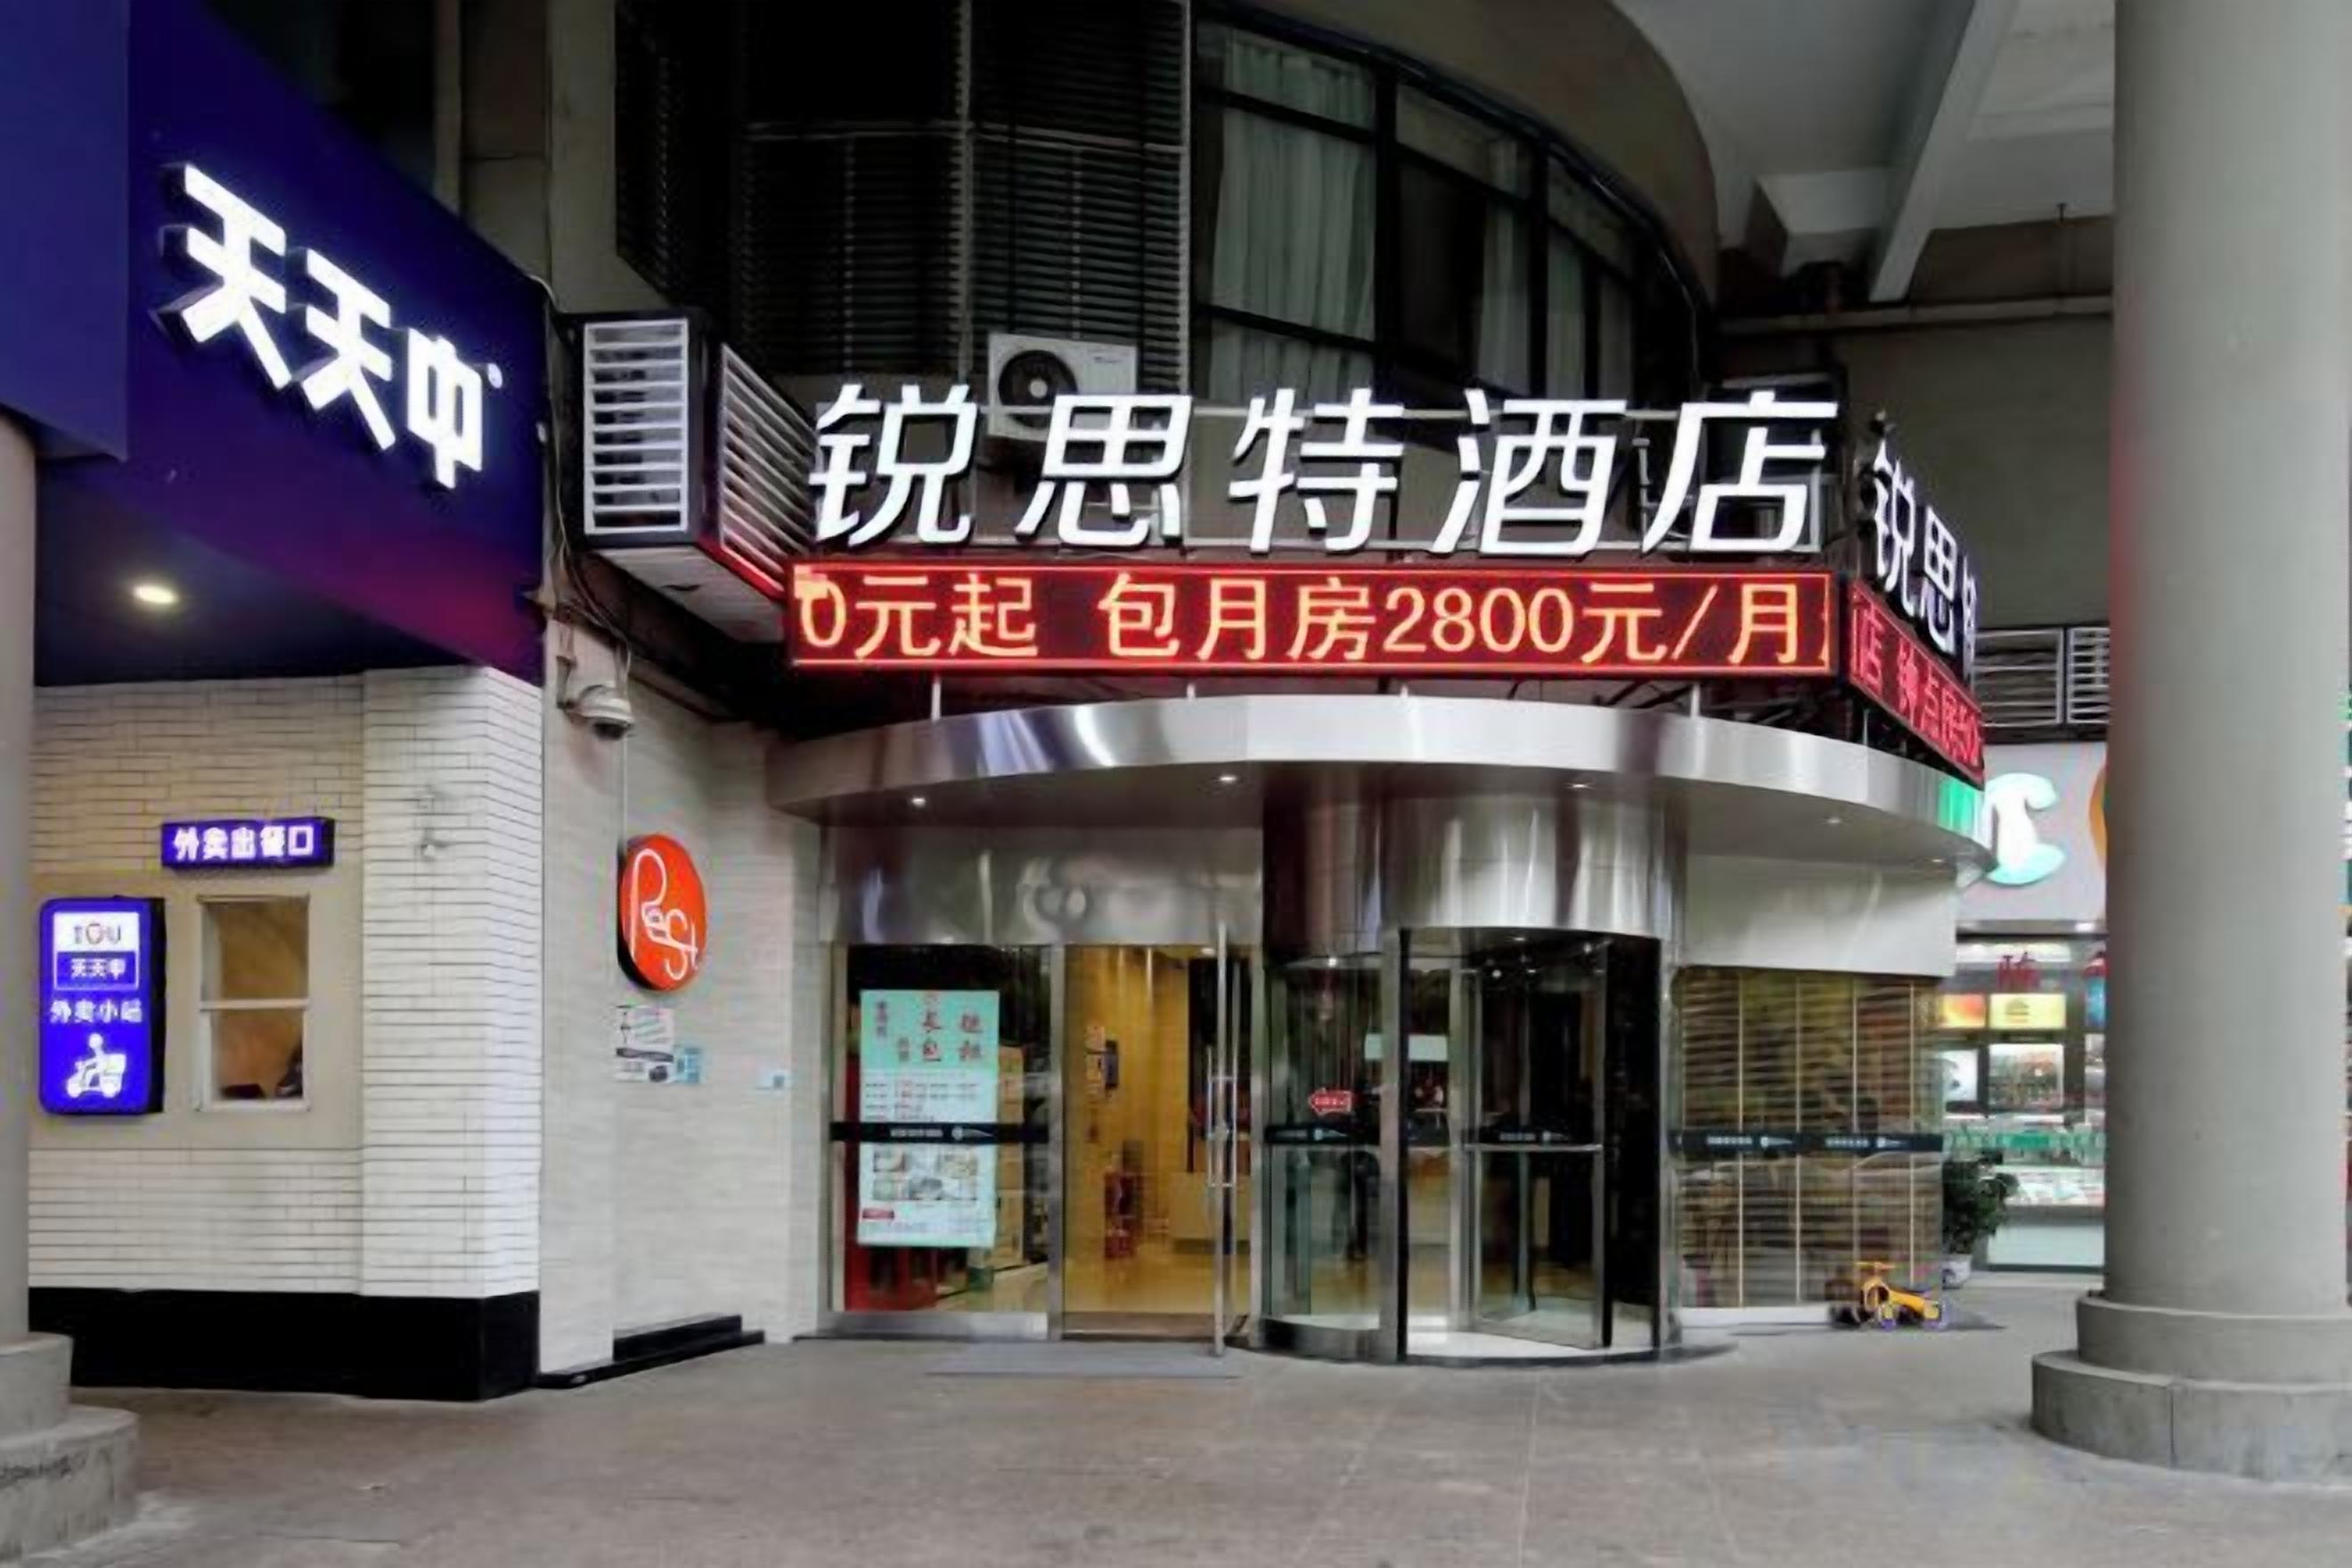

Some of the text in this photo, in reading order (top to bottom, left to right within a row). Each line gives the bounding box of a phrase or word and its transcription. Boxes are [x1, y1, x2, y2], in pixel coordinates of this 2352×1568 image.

[809, 383, 1839, 555] 锐思特酒店
[1098, 573, 1798, 665] 包月房2800元/月
